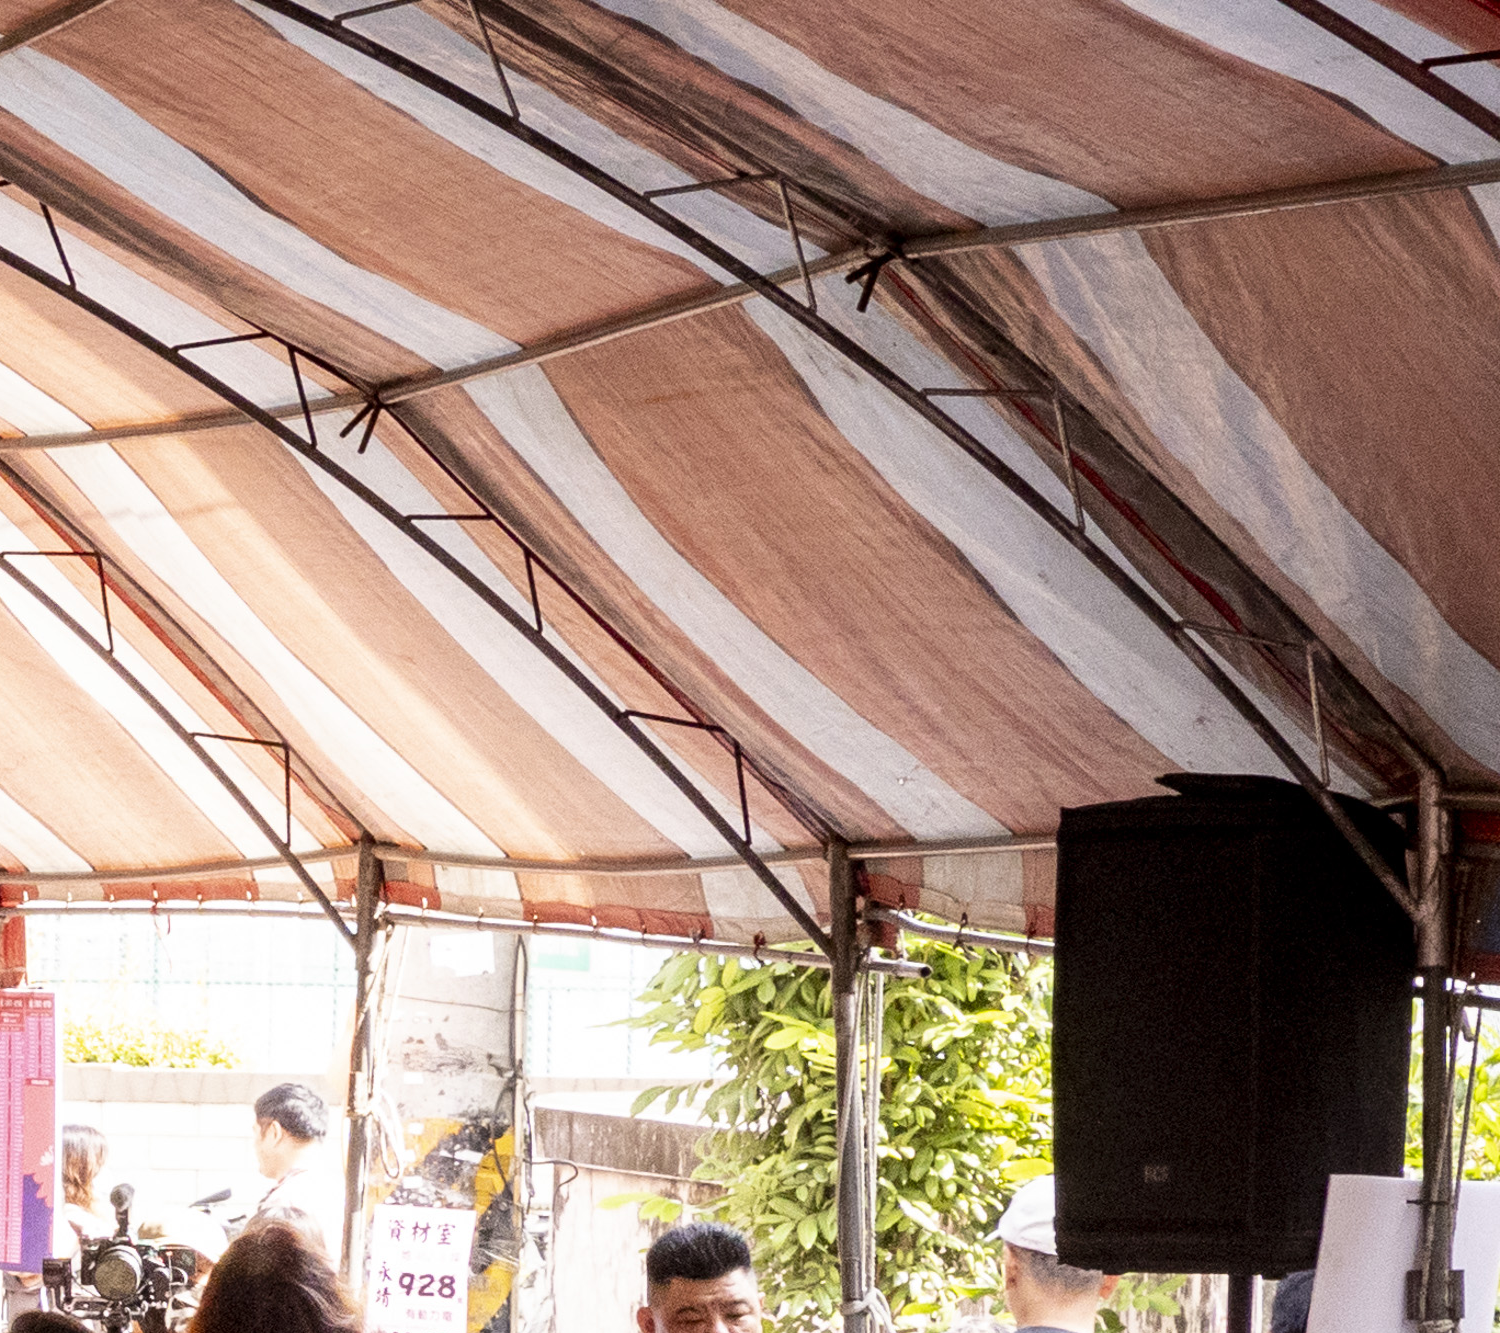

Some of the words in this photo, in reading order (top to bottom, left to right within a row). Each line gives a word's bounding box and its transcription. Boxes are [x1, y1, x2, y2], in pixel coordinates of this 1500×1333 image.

[389, 1219, 456, 1246] 資材室
[375, 1261, 392, 1308] 永靖
[399, 1272, 456, 1299] 928
